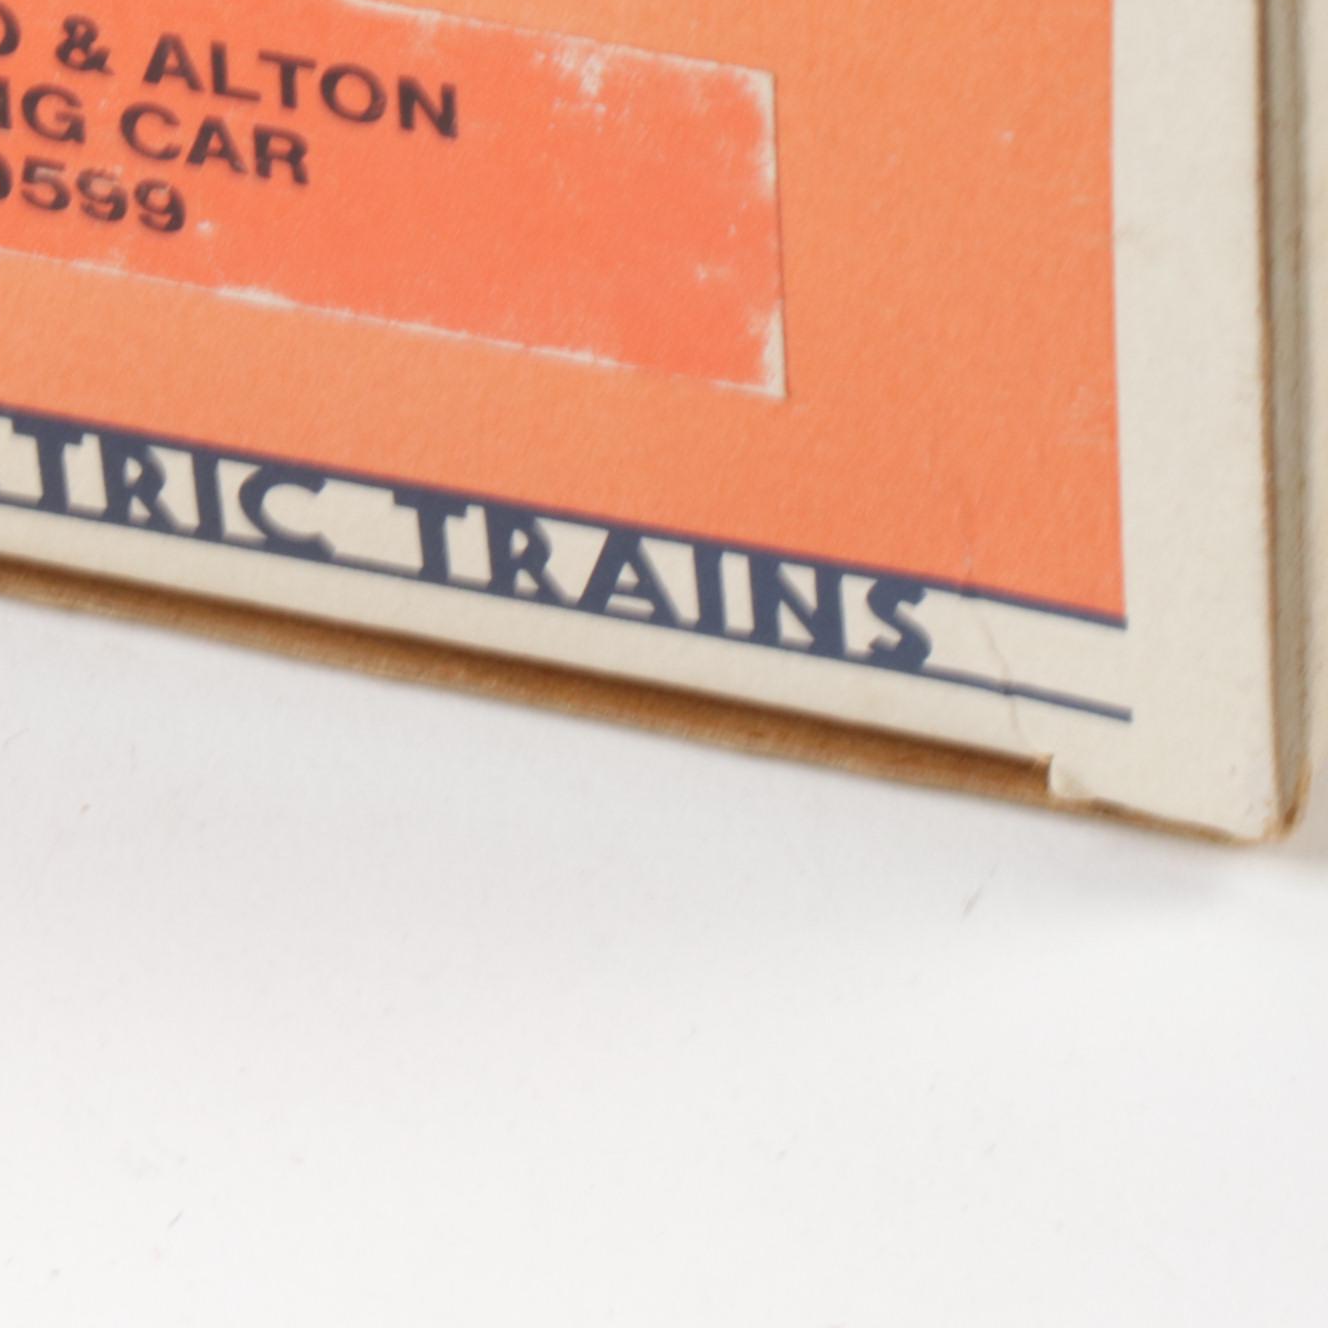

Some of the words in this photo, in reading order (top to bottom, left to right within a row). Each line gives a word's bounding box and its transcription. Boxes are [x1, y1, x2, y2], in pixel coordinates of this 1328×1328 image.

[54, 15, 112, 78] &
[142, 33, 459, 140] ALTON
[118, 102, 310, 186] CAR
[392, 486, 934, 671] TRAINS
